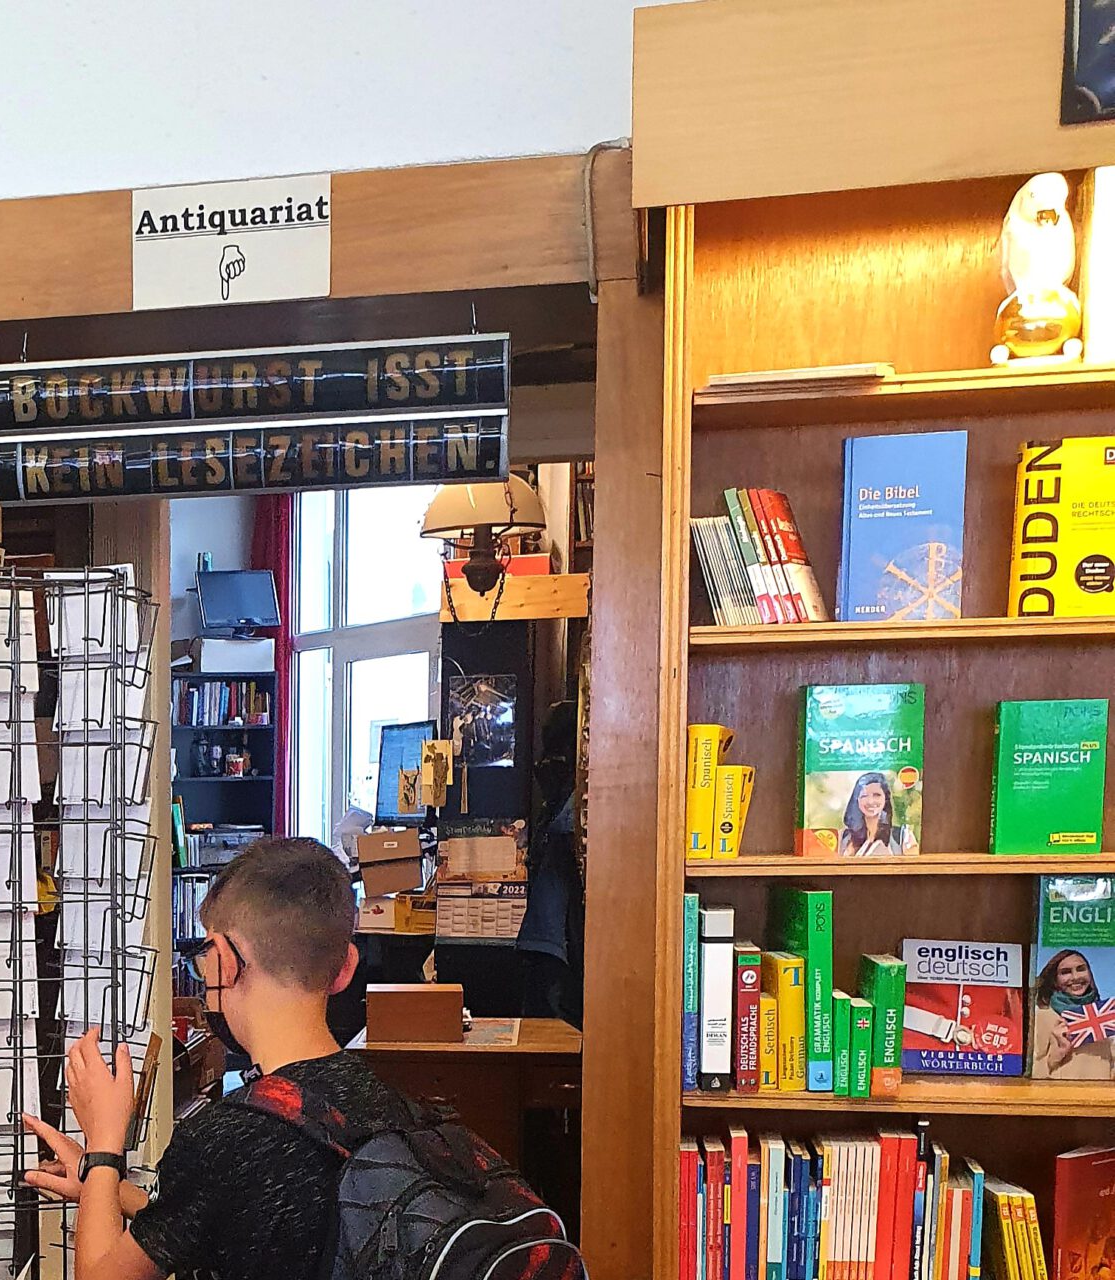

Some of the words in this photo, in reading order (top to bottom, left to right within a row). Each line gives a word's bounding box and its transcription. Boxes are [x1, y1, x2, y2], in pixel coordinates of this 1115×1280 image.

[135, 195, 330, 236] Antiquariat
[12, 360, 322, 424] BOCKWURST
[366, 350, 477, 402] ISST
[23, 441, 125, 495] KEIN
[858, 487, 881, 501] Die
[885, 485, 920, 501] Bibel
[1072, 502, 1086, 510] DIE
[1017, 441, 1062, 617] DUDEN
[855, 605, 886, 614] HERDER
[701, 738, 712, 789] Spanisch
[819, 736, 912, 754] SPANISCH
[1013, 750, 1091, 765] SPANISCH
[723, 772, 734, 820] Spanisch
[814, 902, 827, 933] PONS
[1049, 906, 1115, 924] ENGLI
[917, 945, 1009, 962] englisch
[917, 957, 1009, 978] deutsch
[740, 1016, 750, 1034] ALS
[749, 1004, 759, 1072] FREMDSPRACHE
[763, 1008, 776, 1056] Serbisch
[812, 1000, 822, 1054] GRAMMATIK
[822, 1013, 830, 1054] ENGLISCH
[884, 1008, 897, 1068] ENGLISCH
[740, 1035, 750, 1072] DEUTSCH
[839, 1048, 849, 1087] ENGLISCH
[857, 1048, 868, 1092] ENGLISCH
[921, 1051, 1003, 1061] VISUELLES
[921, 1058, 1003, 1072] WÖRTERBUCH
